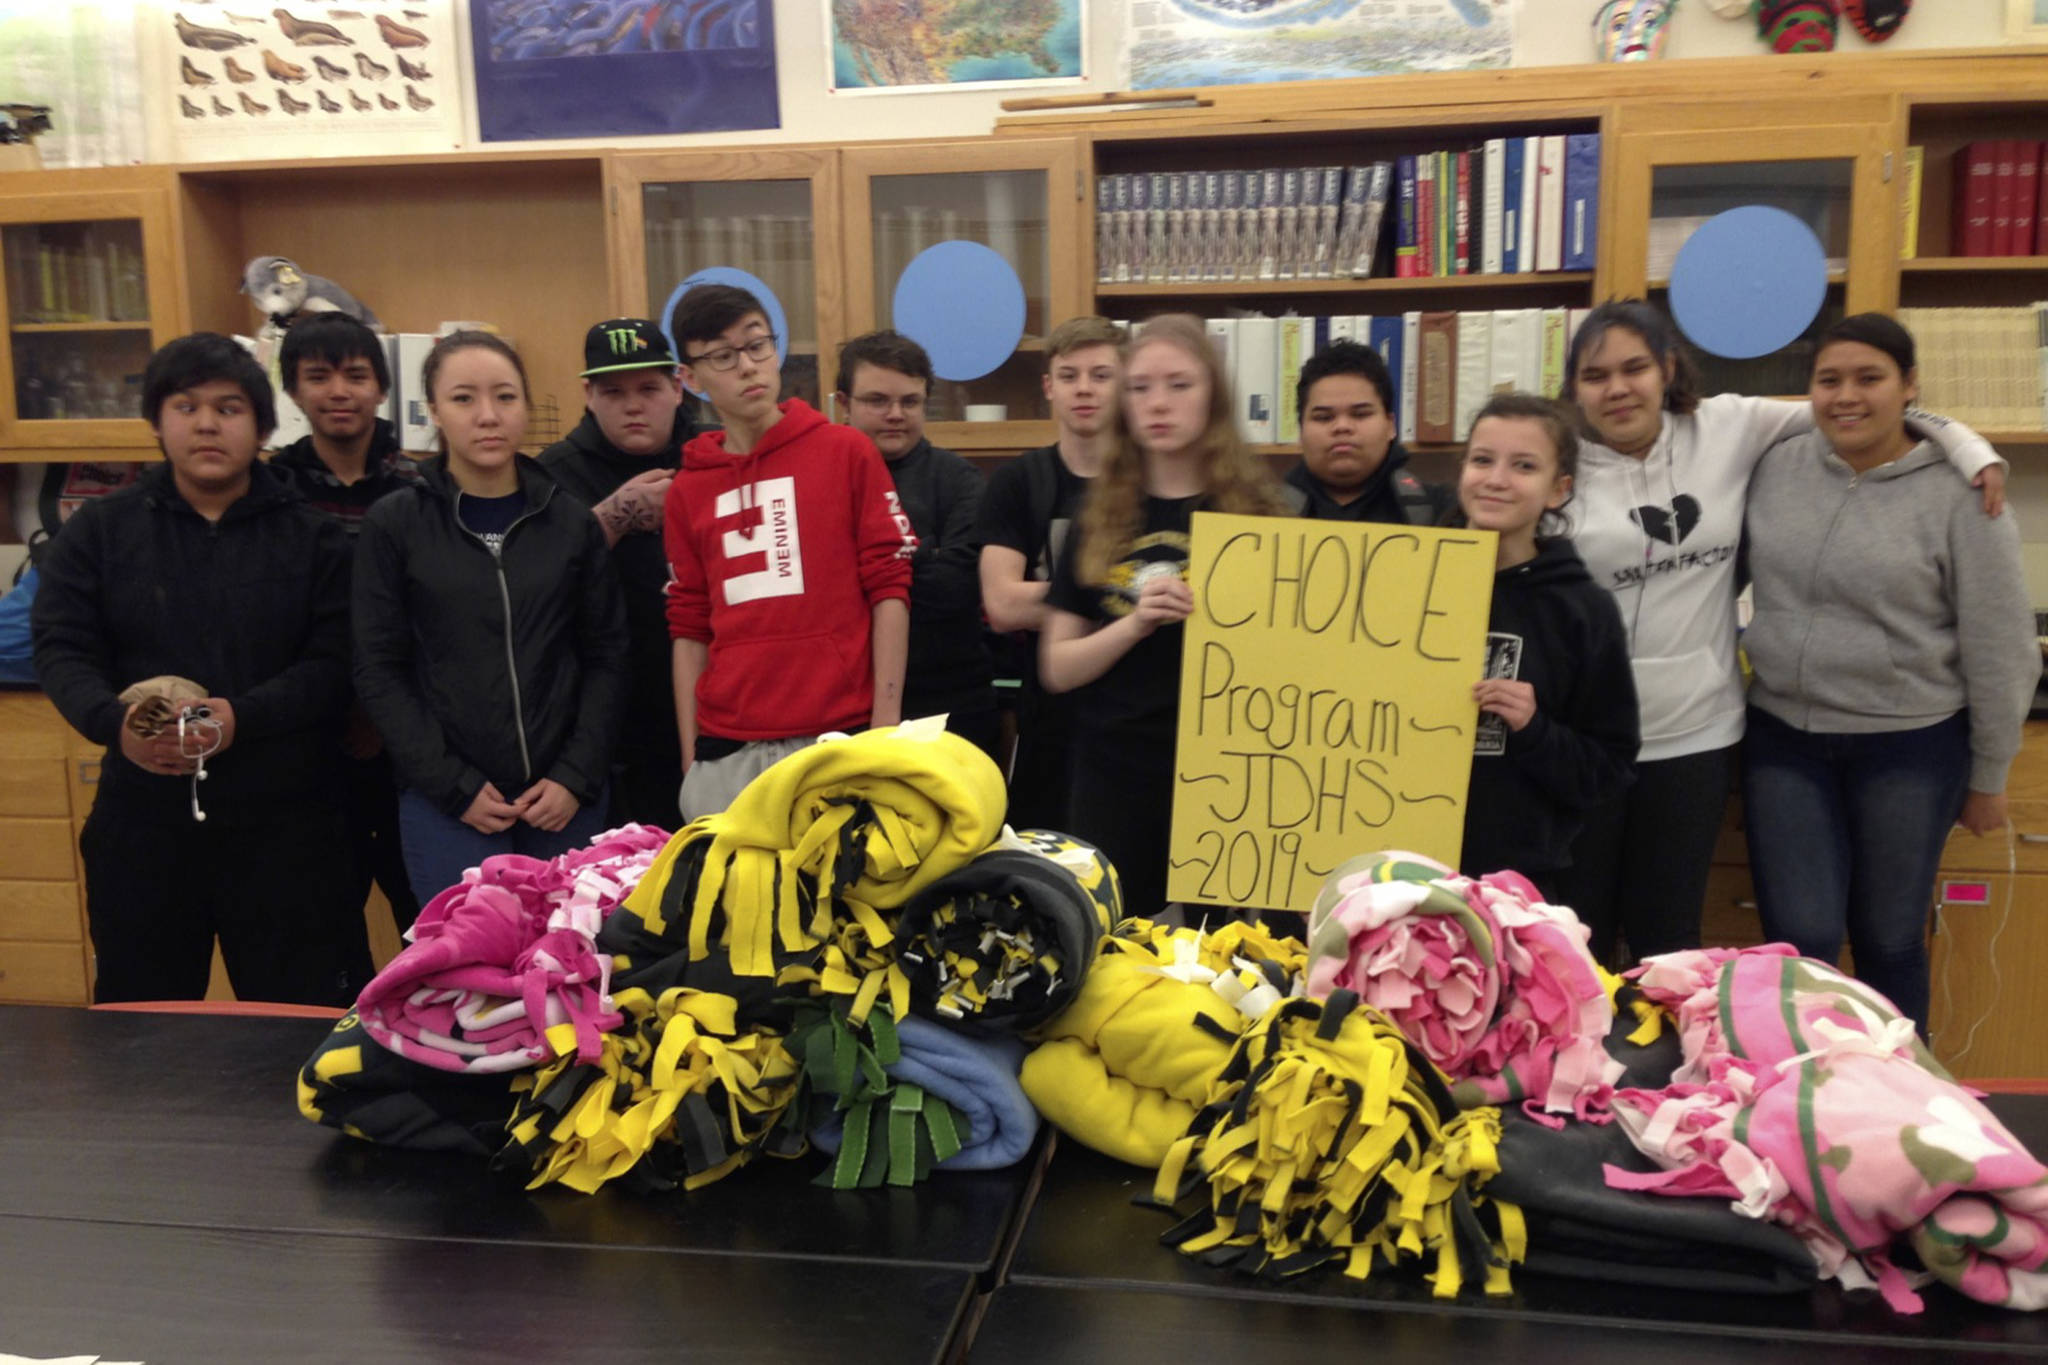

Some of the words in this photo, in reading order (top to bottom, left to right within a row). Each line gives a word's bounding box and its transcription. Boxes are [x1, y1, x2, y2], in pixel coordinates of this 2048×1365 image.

[1204, 531, 1480, 662] CHOICE
[1198, 641, 1399, 757] Program
[1208, 750, 1396, 835] JDHS
[1195, 829, 1303, 908] 2019
